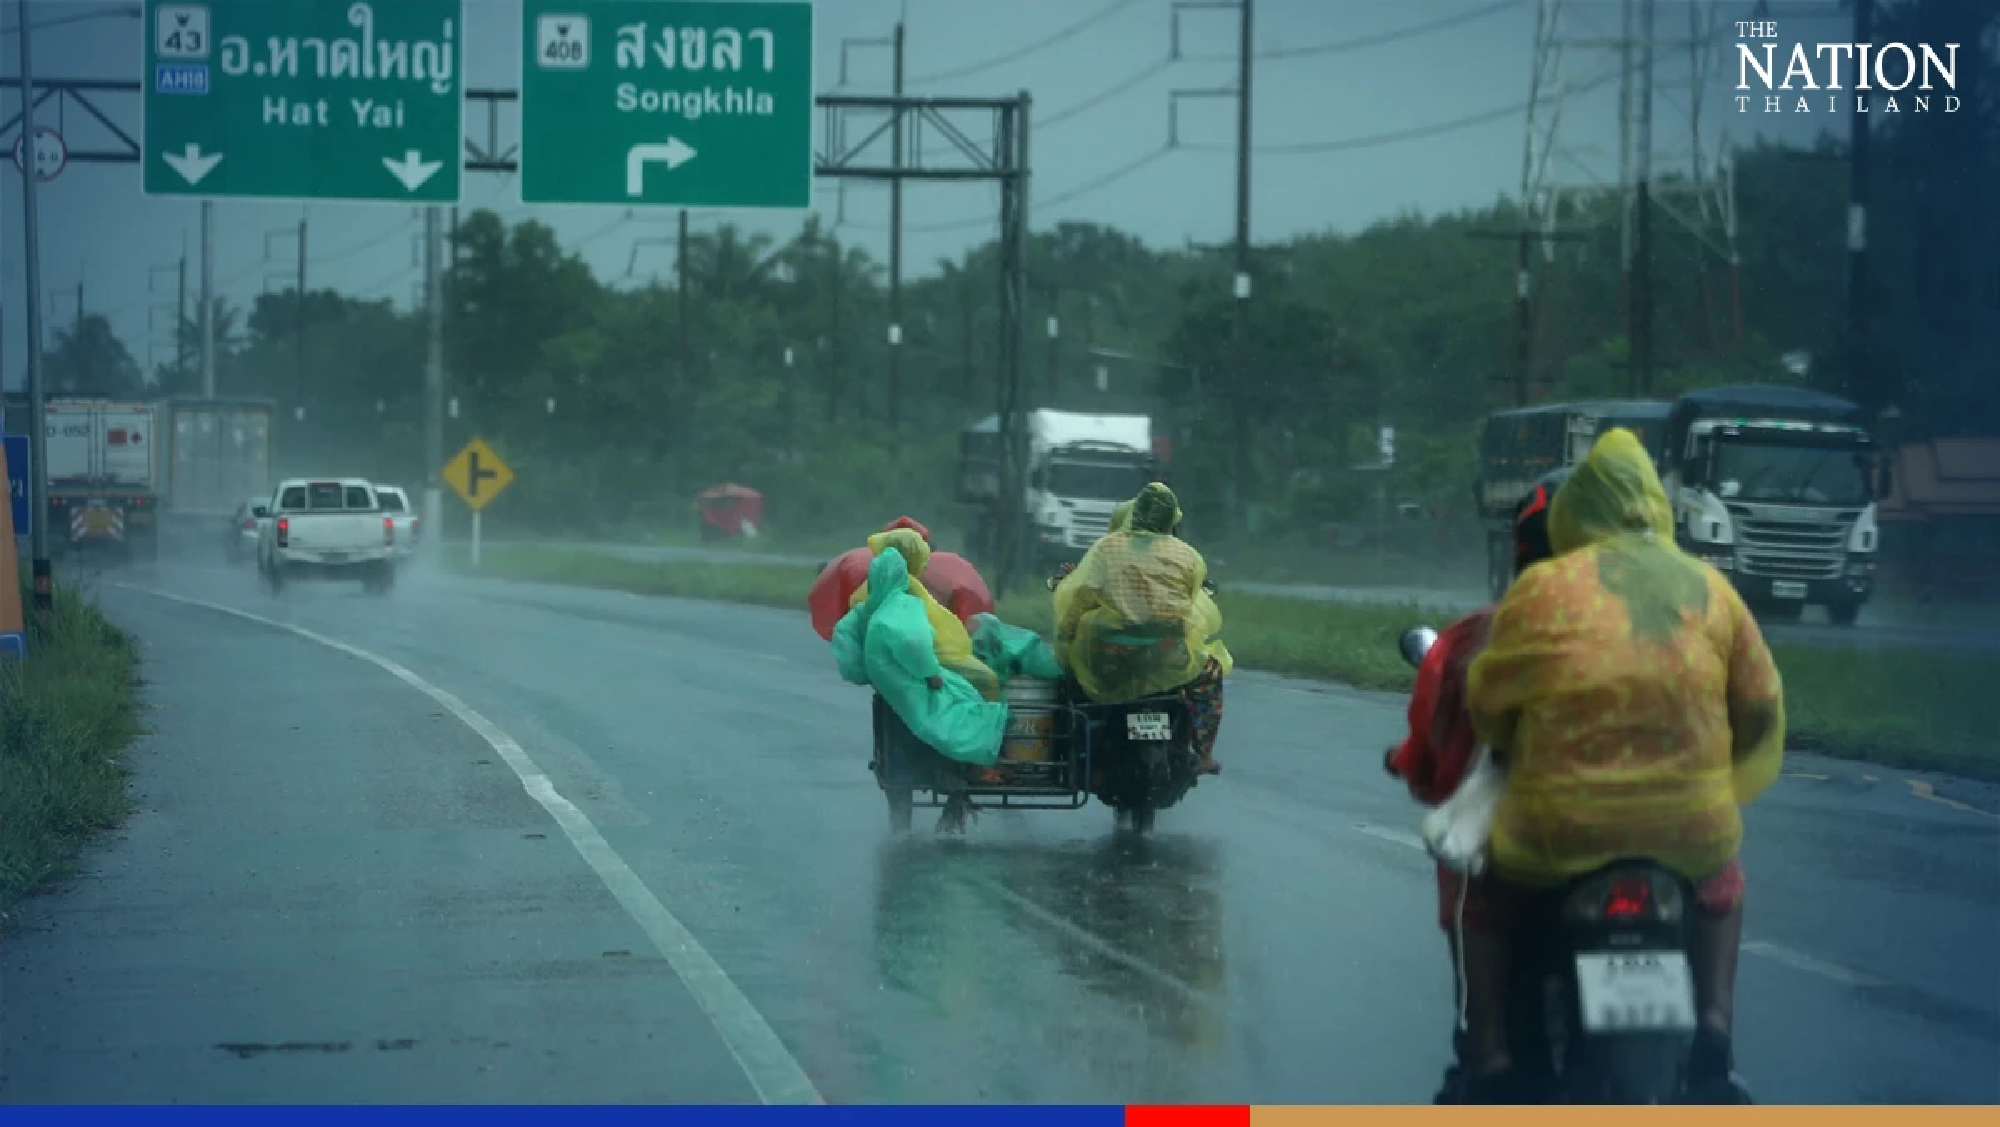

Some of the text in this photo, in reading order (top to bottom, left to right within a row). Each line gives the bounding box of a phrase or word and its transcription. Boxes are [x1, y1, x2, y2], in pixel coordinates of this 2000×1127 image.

[164, 29, 202, 53] 43
[220, 2, 454, 95] อ.หาดใหญ่
[545, 40, 583, 61] 408
[616, 21, 774, 72] สงขลา
[262, 95, 405, 128] Hat Yai
[616, 82, 774, 120] Songkhla
